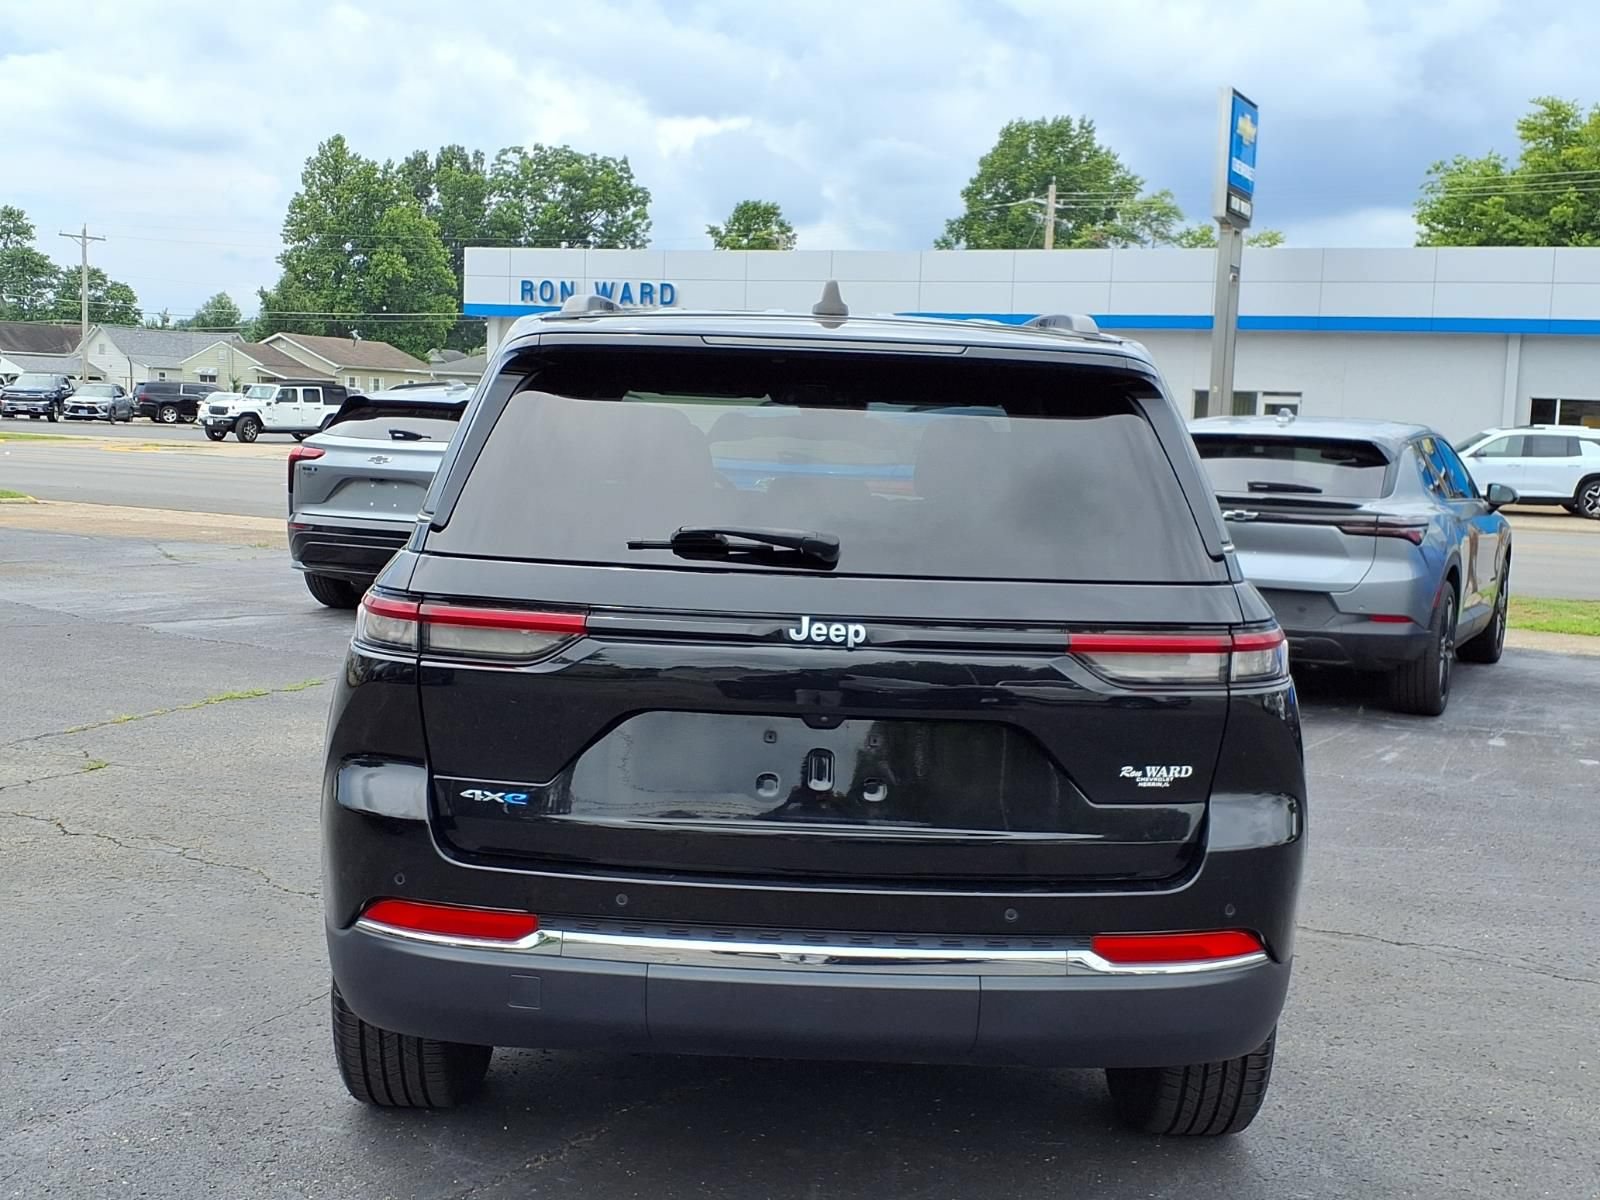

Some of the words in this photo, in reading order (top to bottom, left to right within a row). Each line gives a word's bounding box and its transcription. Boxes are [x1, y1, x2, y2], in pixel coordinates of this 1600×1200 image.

[520, 280, 575, 302] RON
[594, 281, 676, 305] WARD
[788, 615, 866, 648] Jeep
[1145, 765, 1193, 778] WARD
